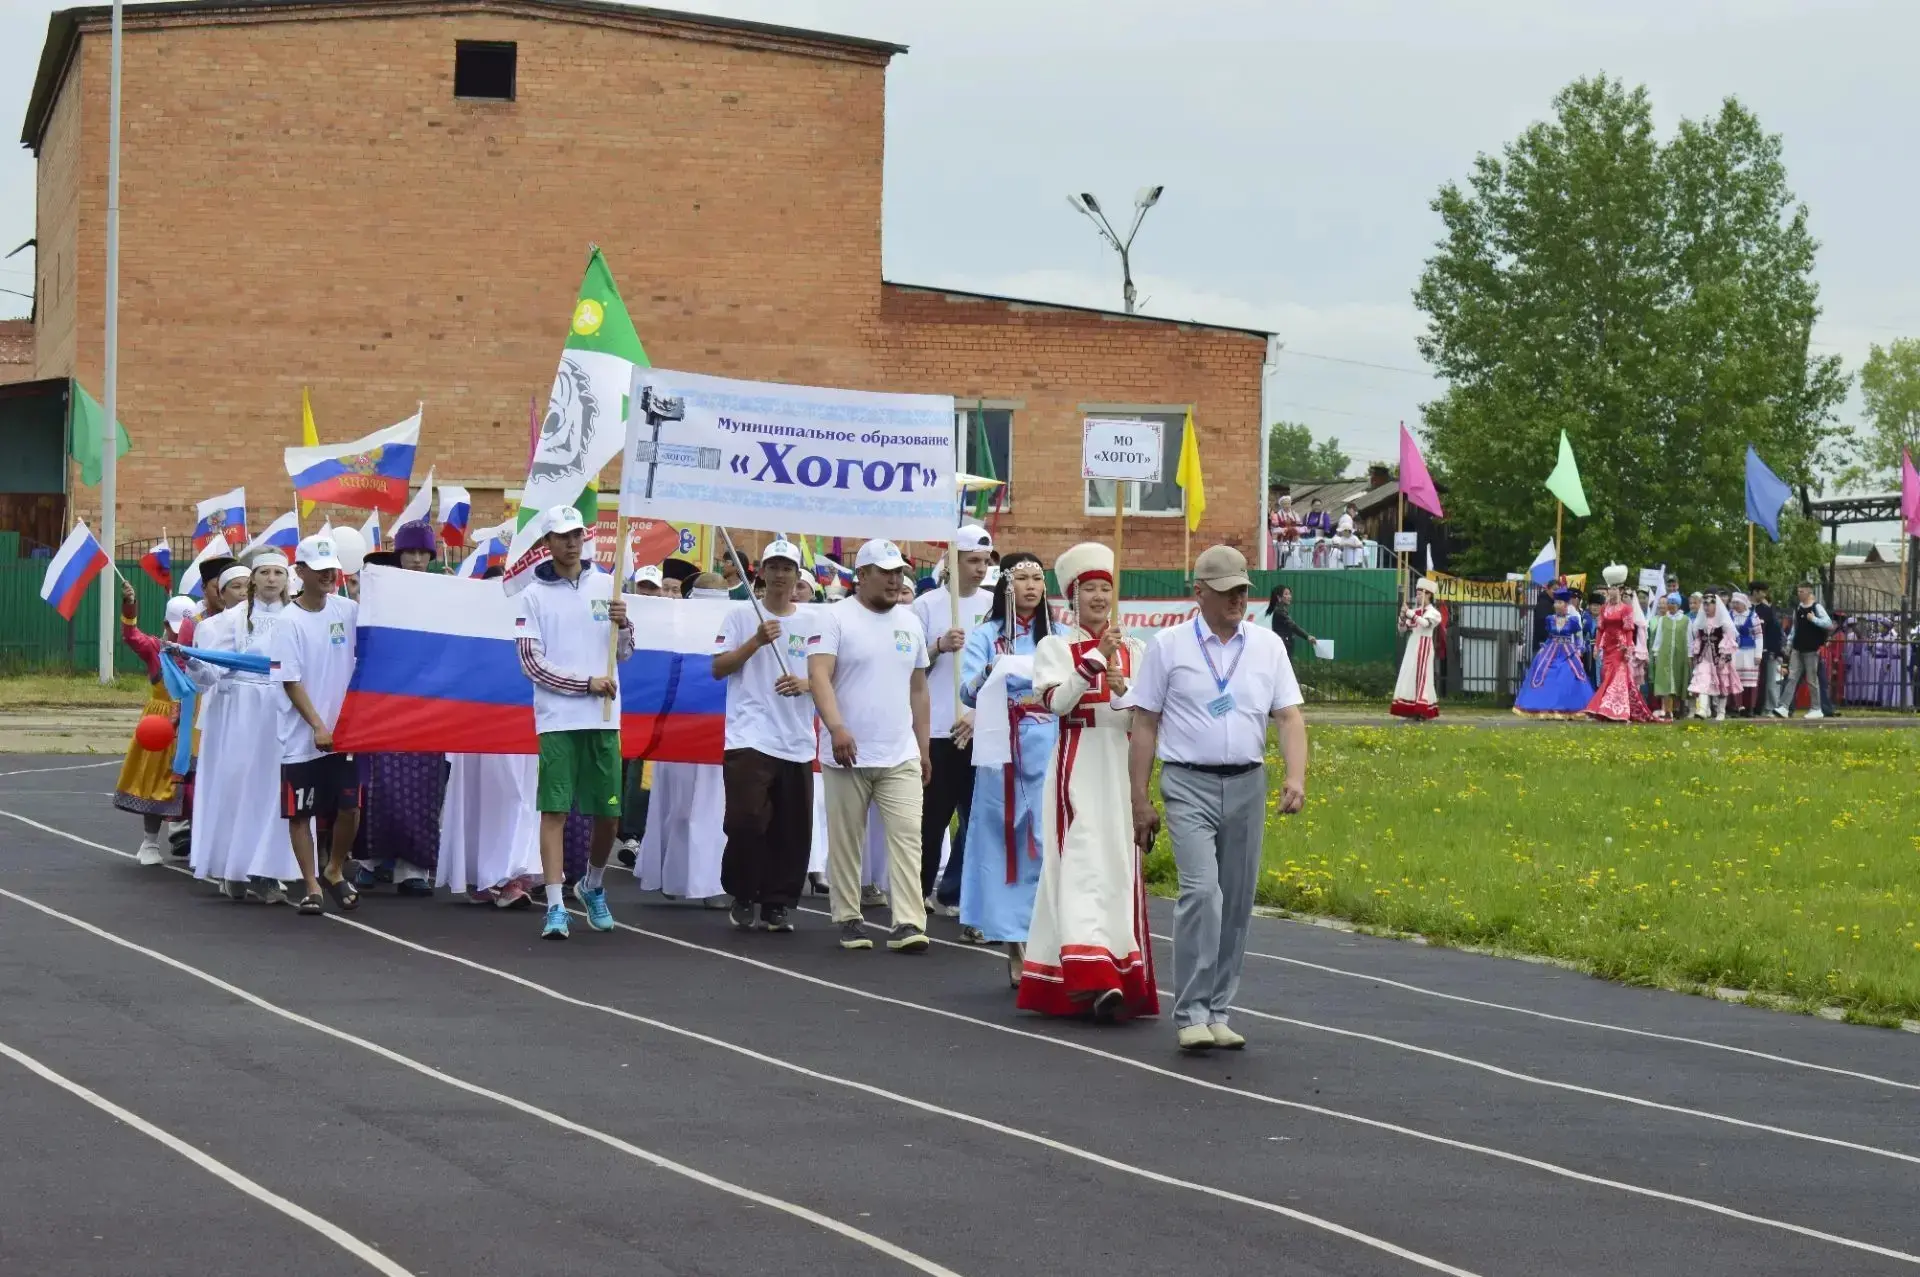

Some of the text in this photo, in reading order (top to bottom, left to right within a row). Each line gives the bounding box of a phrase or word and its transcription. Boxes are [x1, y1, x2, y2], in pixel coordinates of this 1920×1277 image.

[718, 417, 949, 447] Муниципальное образование
[1113, 435, 1133, 447] МО
[730, 441, 938, 493] «Хогот»
[1094, 451, 1151, 464] «ХОГОТ»
[295, 787, 315, 811] 14
